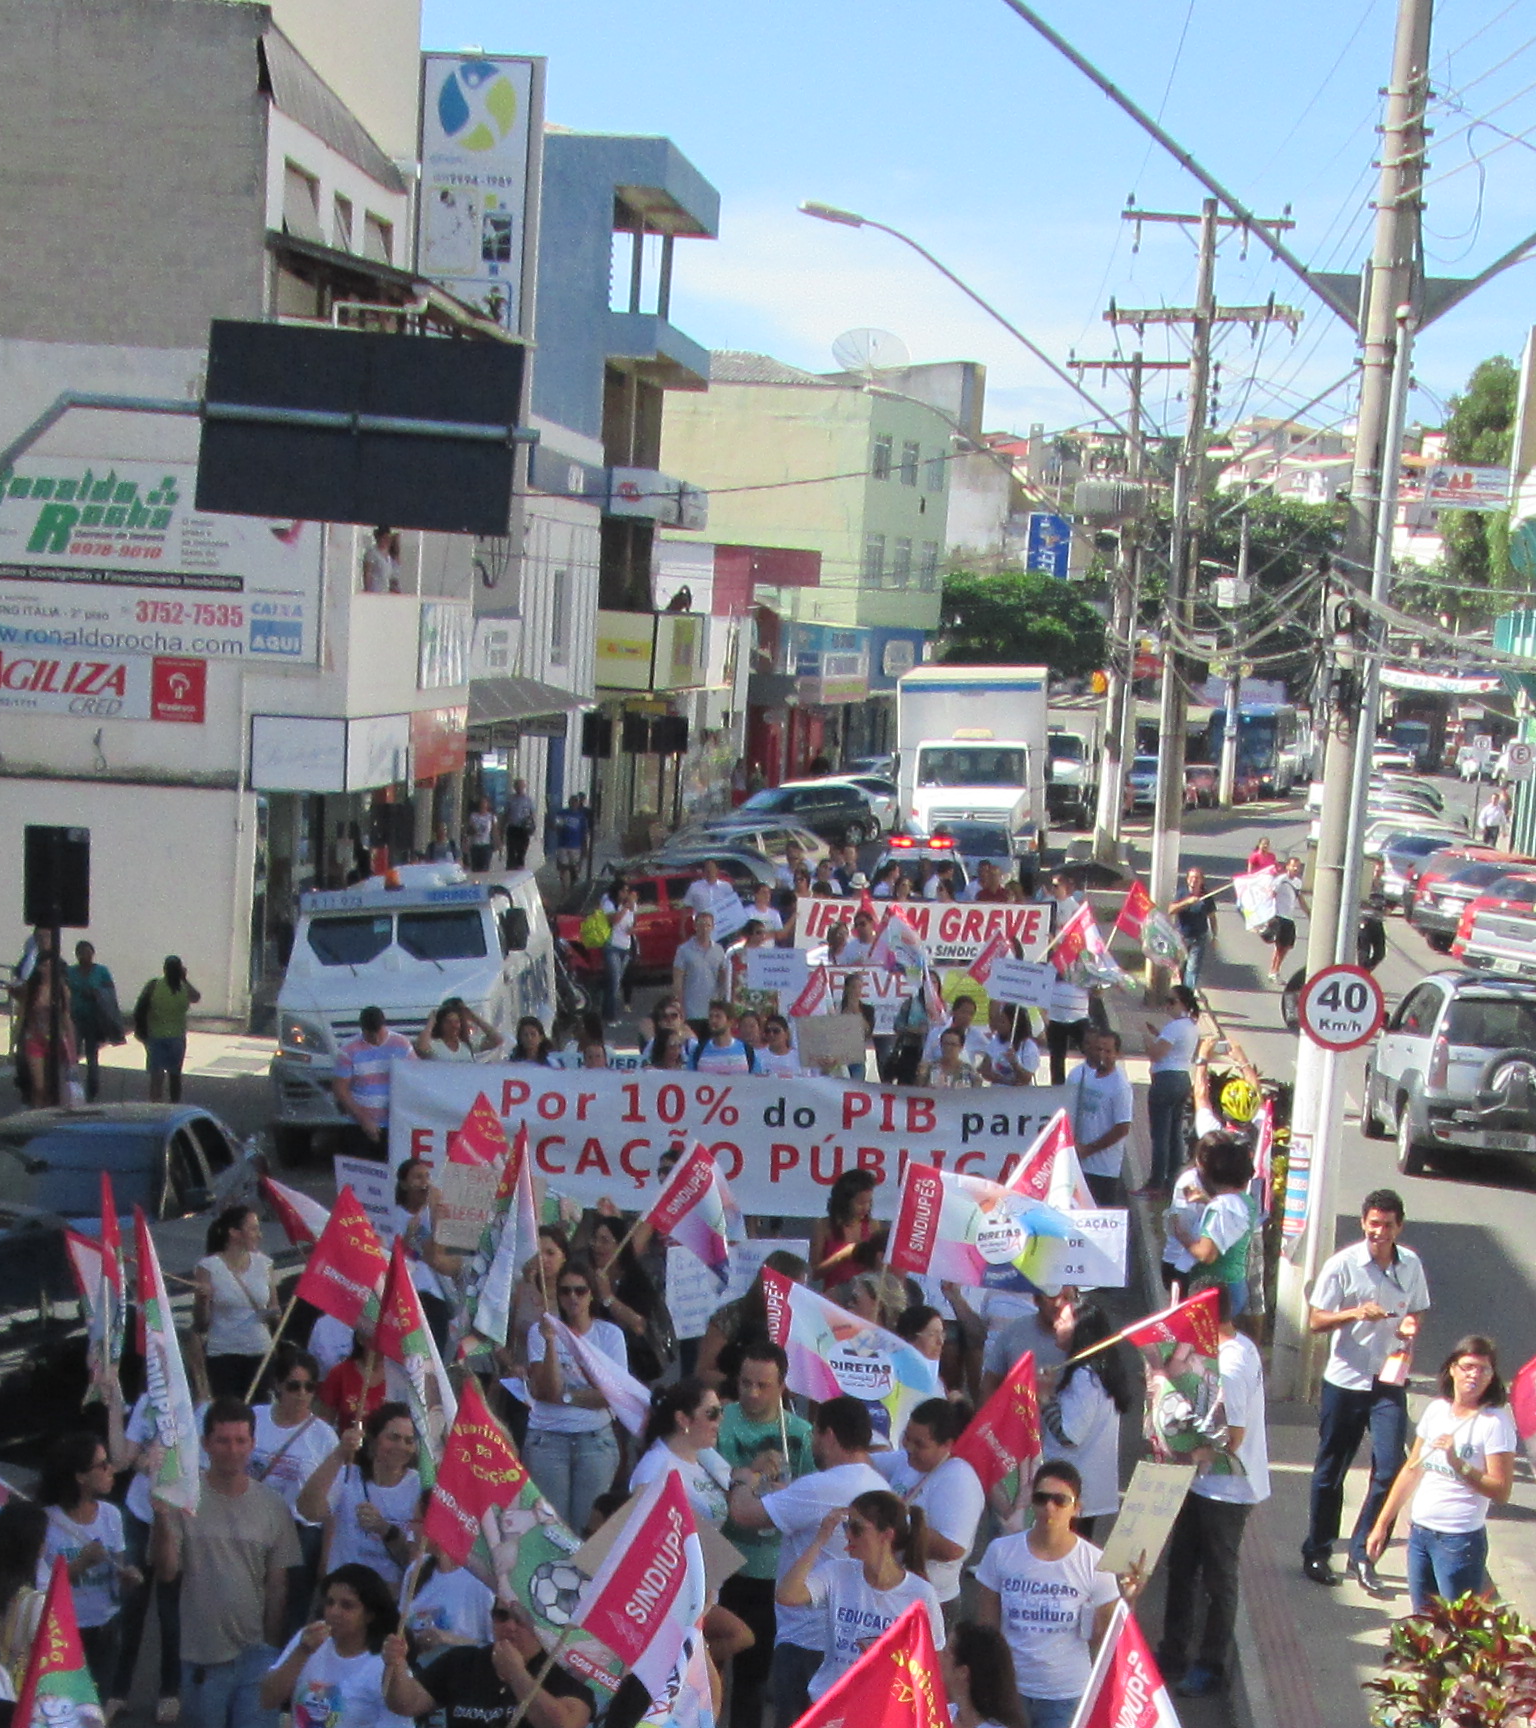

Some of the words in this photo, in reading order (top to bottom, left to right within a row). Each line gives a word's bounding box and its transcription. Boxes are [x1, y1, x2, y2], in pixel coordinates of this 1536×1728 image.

[26, 495, 174, 554] Rocha
[135, 600, 243, 628] 3752-7535
[251, 602, 303, 617] CAIXA
[252, 634, 302, 653] AQUI
[68, 698, 123, 716] CRED
[939, 907, 1042, 945] GREVE
[935, 945, 978, 959] SINDIC
[1317, 981, 1368, 1013] 40
[1319, 1018, 1363, 1034] Km/h
[501, 1079, 597, 1121] Por
[620, 1083, 740, 1127] 10%
[764, 1097, 816, 1129] do
[842, 1091, 937, 1134] PIB
[410, 1128, 745, 1190] ECAÇO
[830, 1359, 892, 1374] DIRETAS
